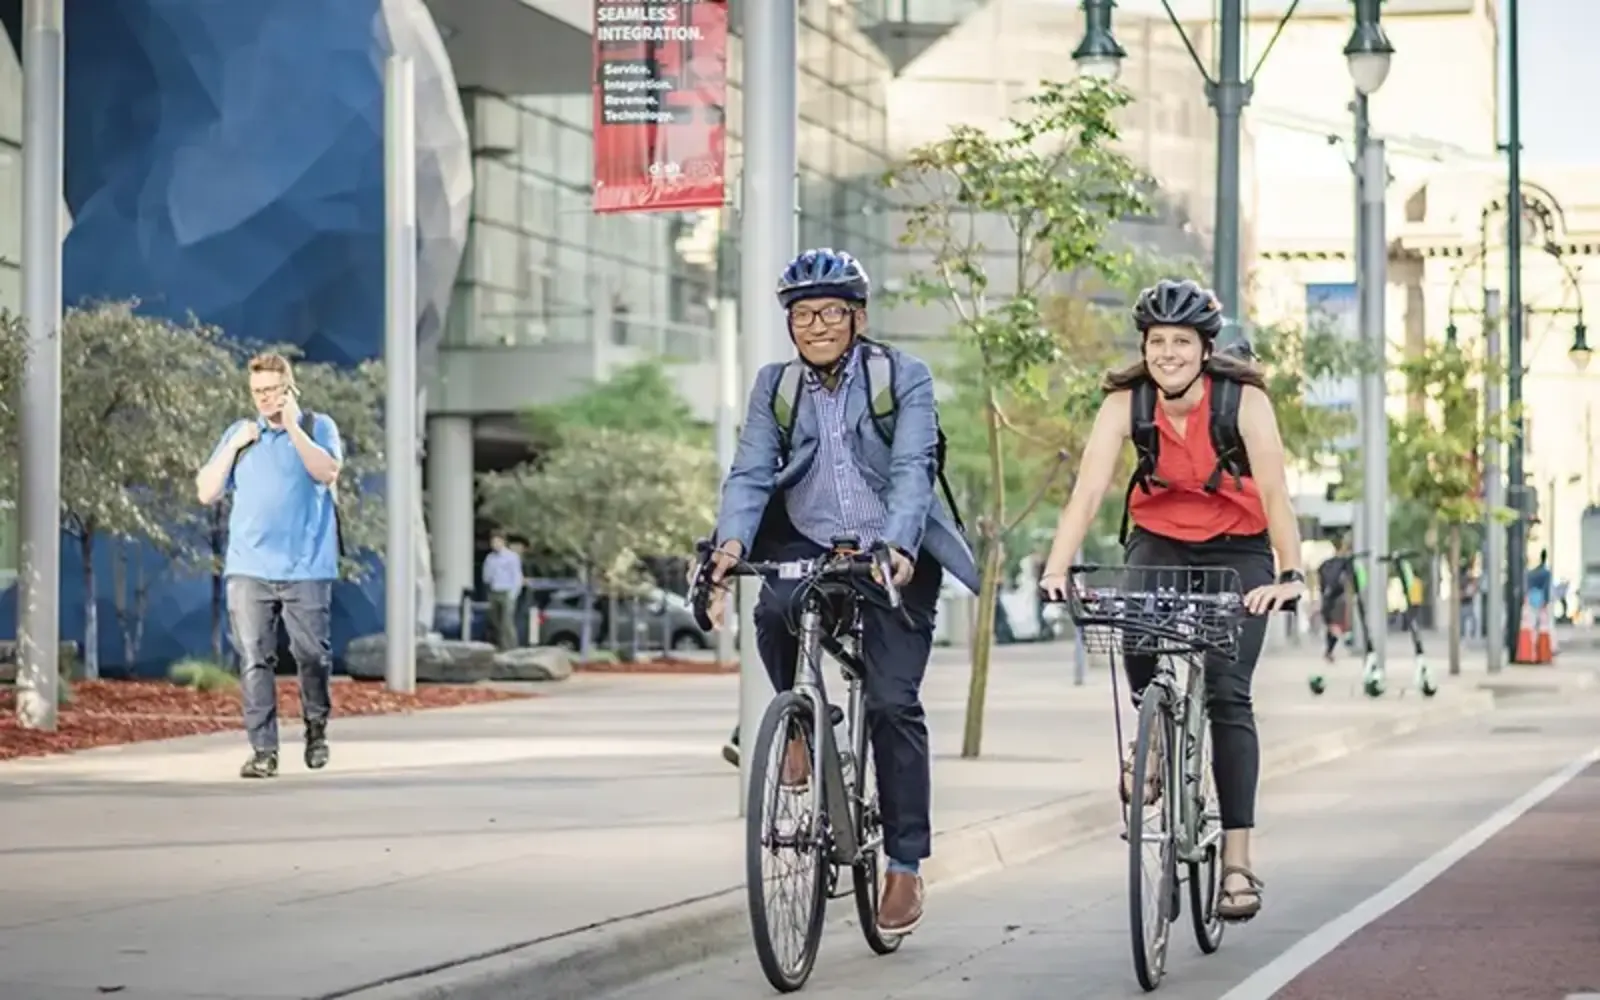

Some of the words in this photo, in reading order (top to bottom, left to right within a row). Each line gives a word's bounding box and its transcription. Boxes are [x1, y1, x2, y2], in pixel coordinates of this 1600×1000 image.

[597, 7, 677, 21] SEAMLESS
[597, 26, 704, 41] INTEGRATION.
[604, 63, 651, 75] Service.
